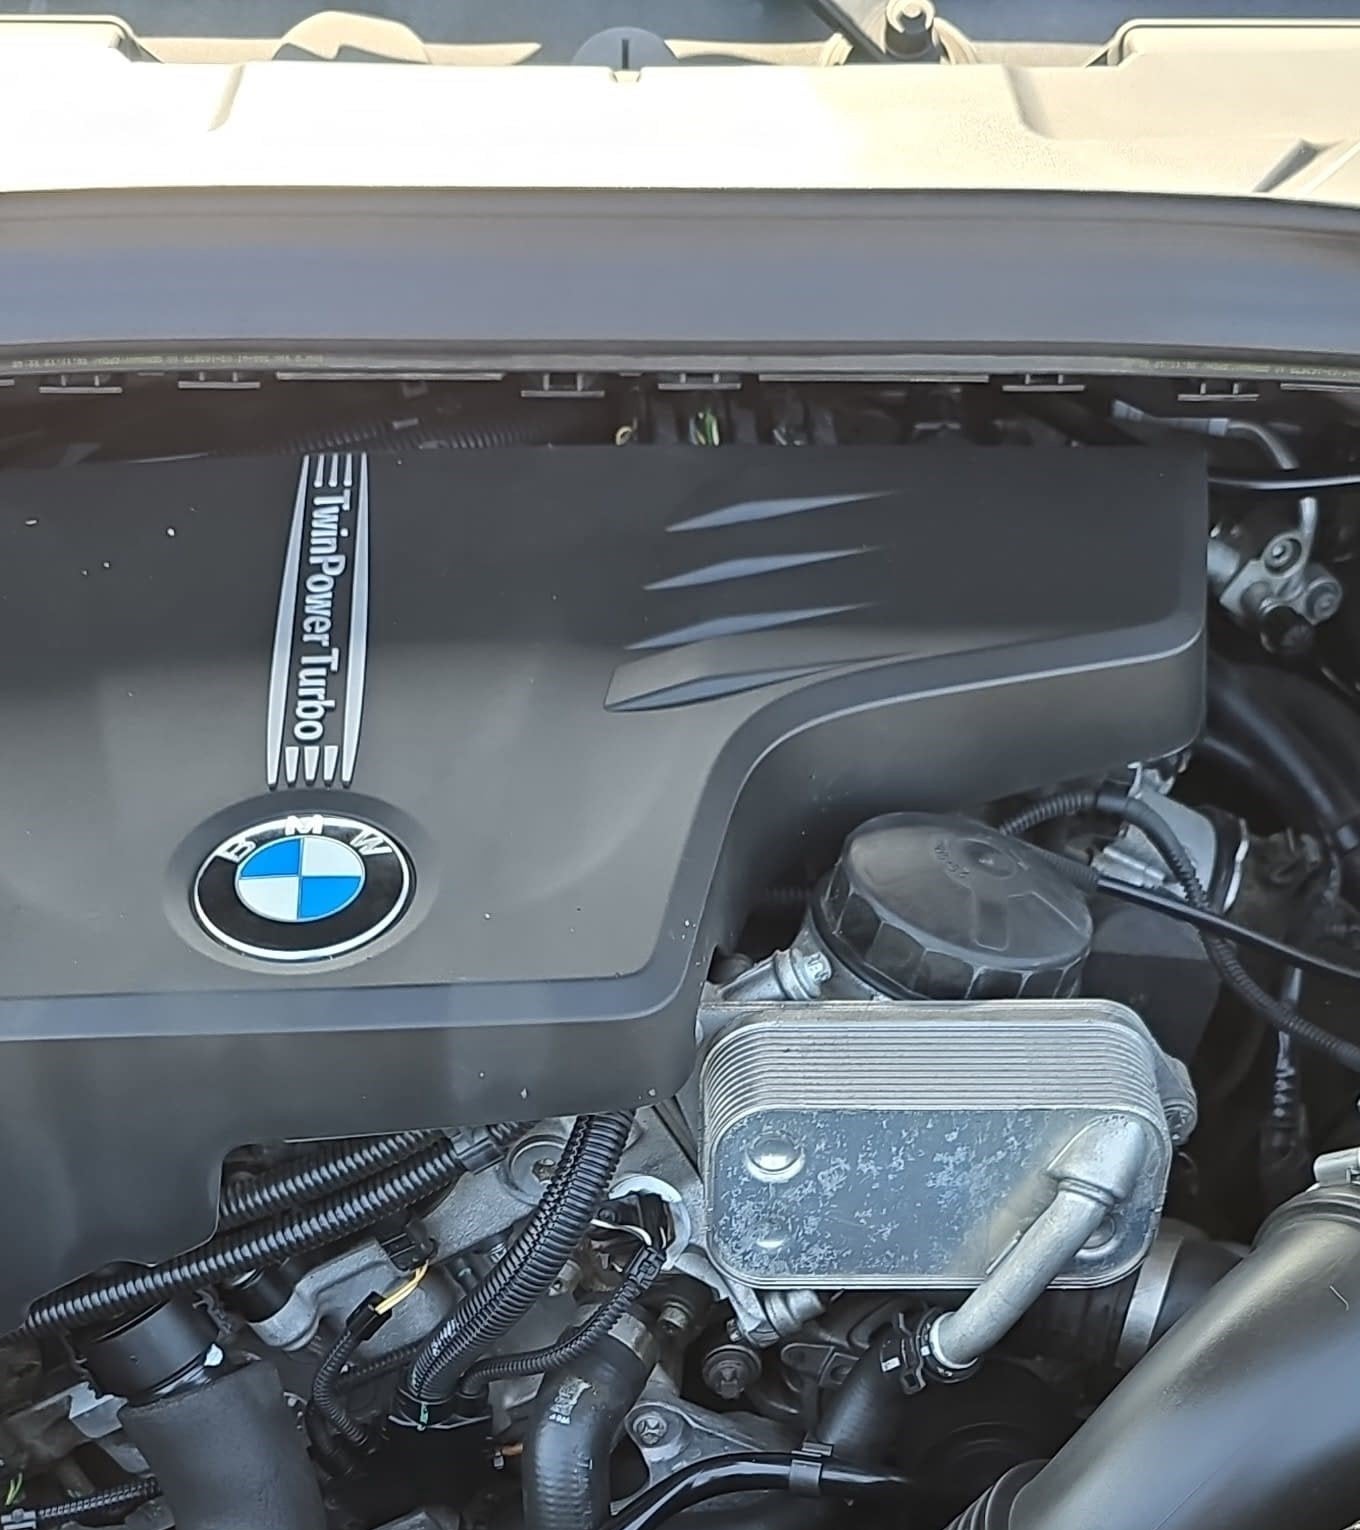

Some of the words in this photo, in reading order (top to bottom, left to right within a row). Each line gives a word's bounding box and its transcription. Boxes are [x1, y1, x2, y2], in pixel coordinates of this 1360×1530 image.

[301, 488, 351, 647] TwinPower
[292, 647, 340, 741] Turbo
[215, 814, 394, 863] BMW
